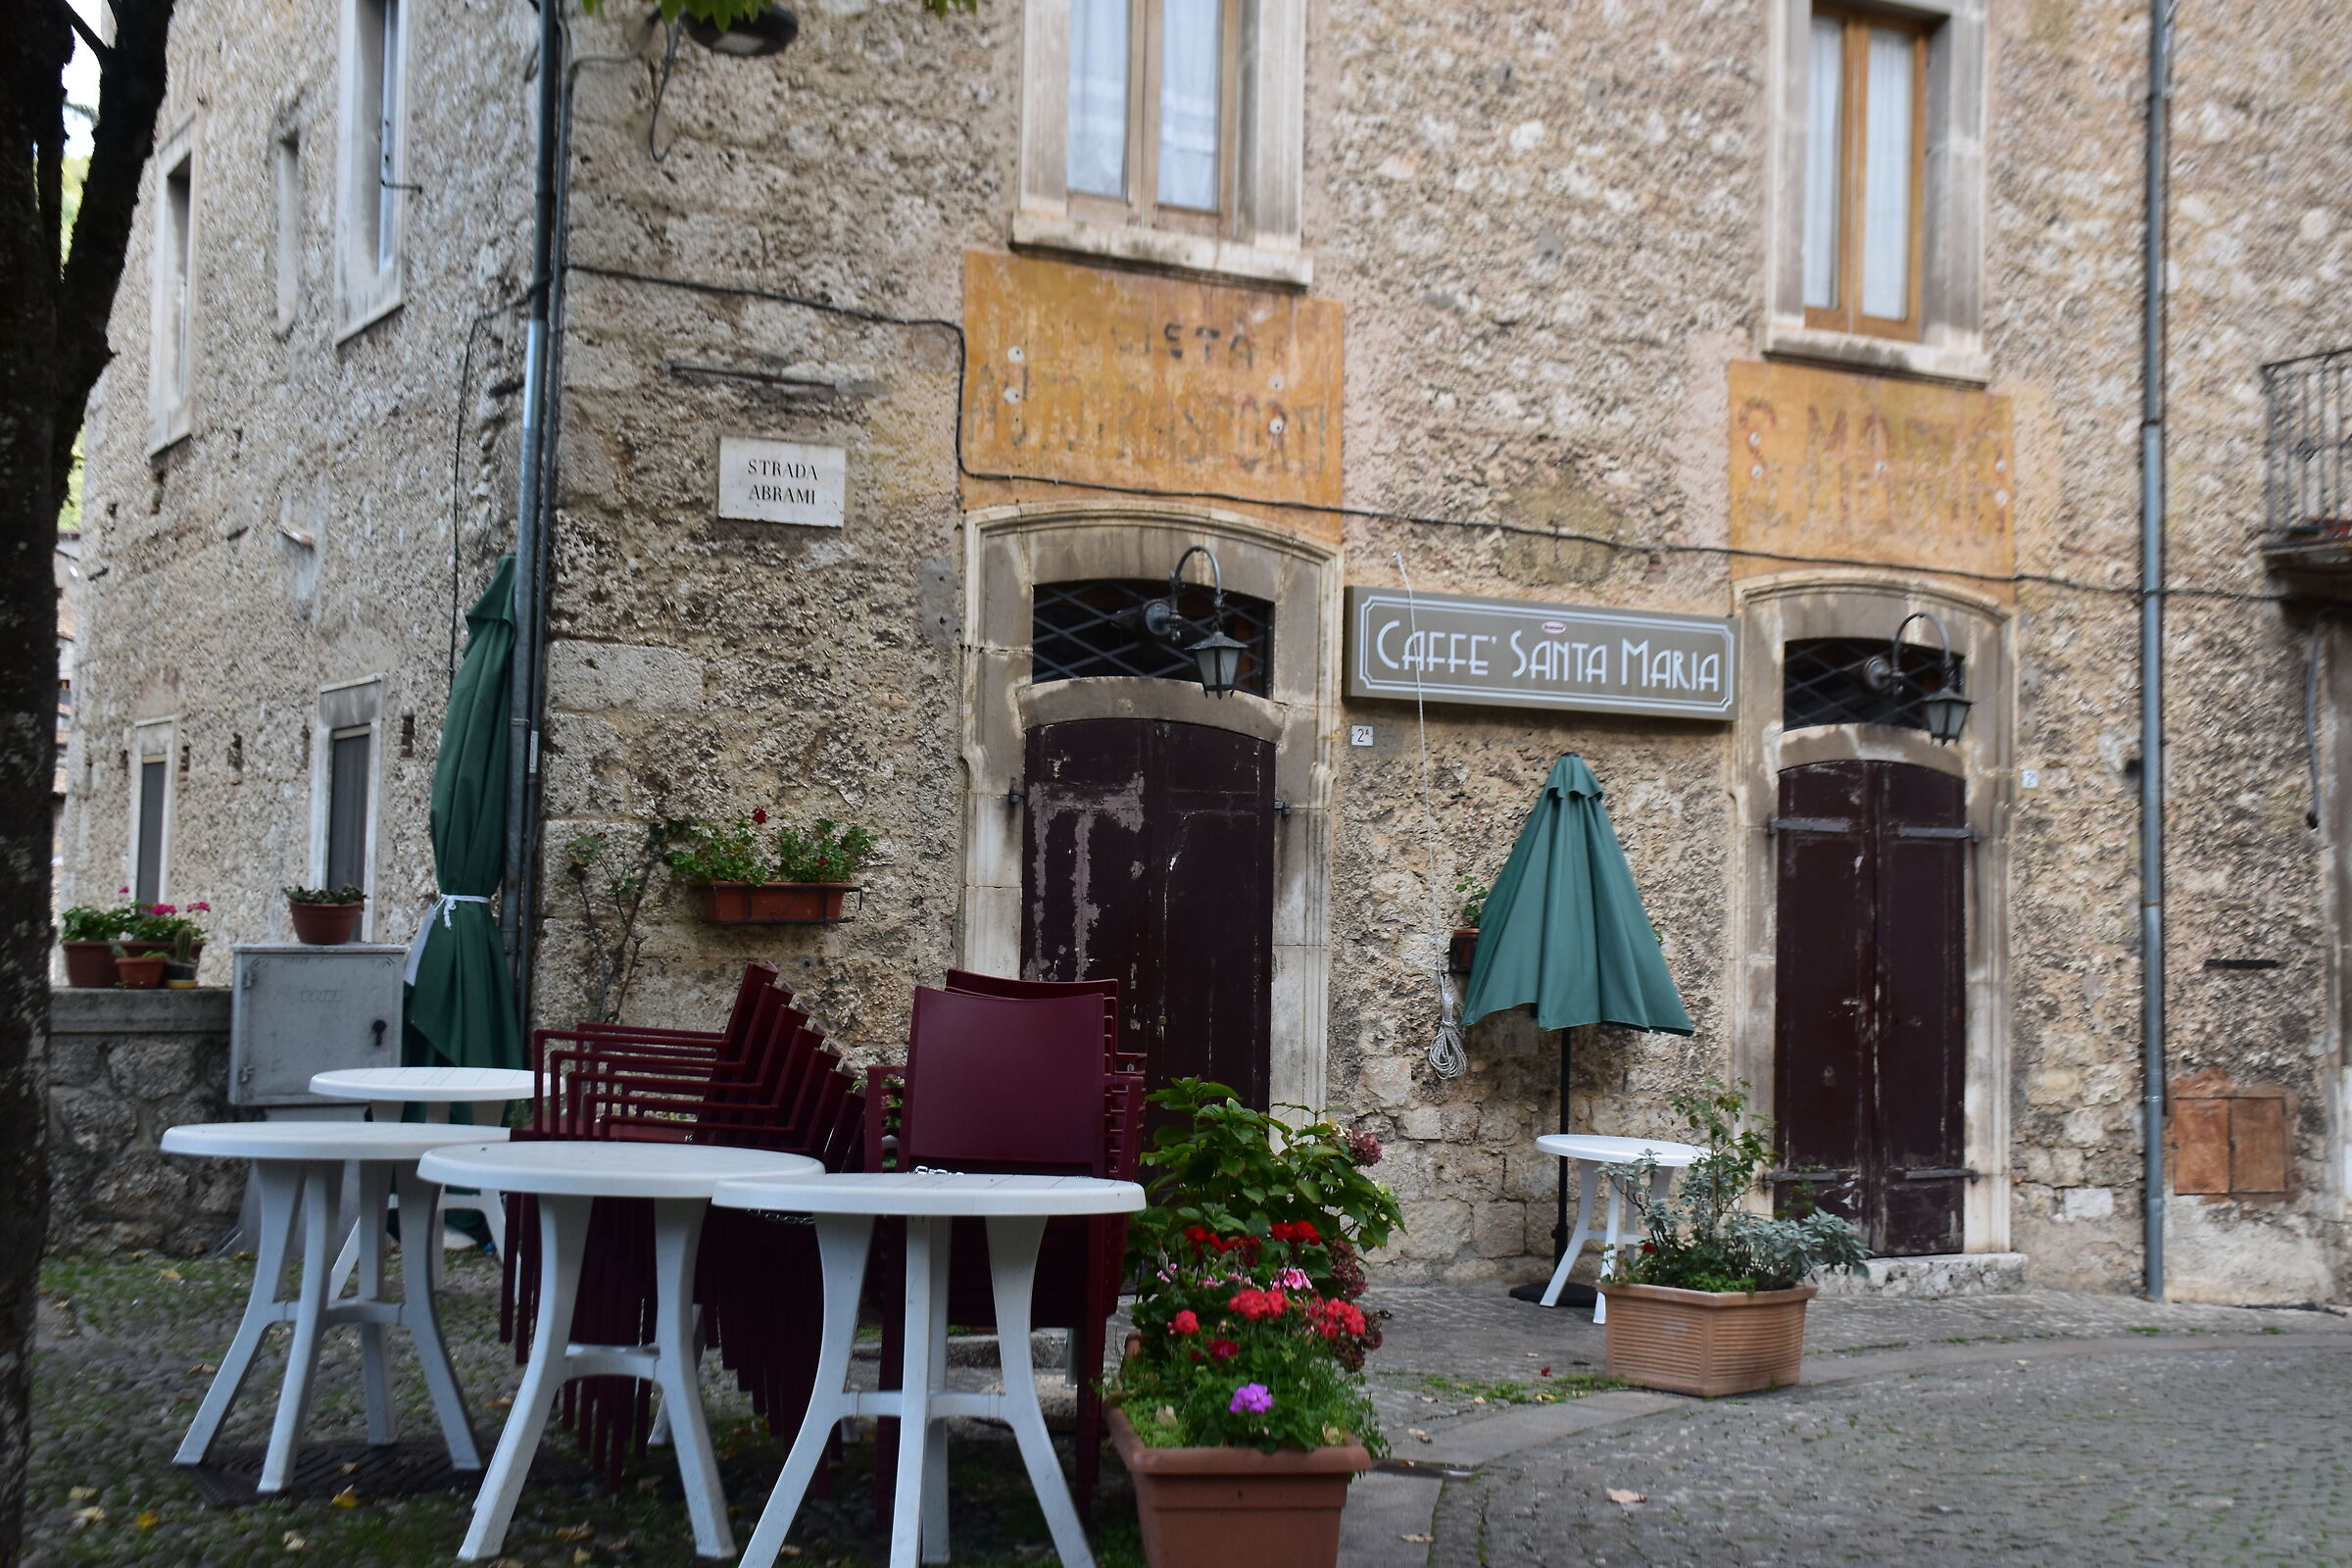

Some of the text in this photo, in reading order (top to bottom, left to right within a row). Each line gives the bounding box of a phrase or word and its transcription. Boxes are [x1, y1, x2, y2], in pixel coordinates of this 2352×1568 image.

[748, 459, 818, 481] STRADA
[749, 484, 816, 506] ABRAMI
[1376, 619, 1720, 693] CAFFE' SANTA MARIA
